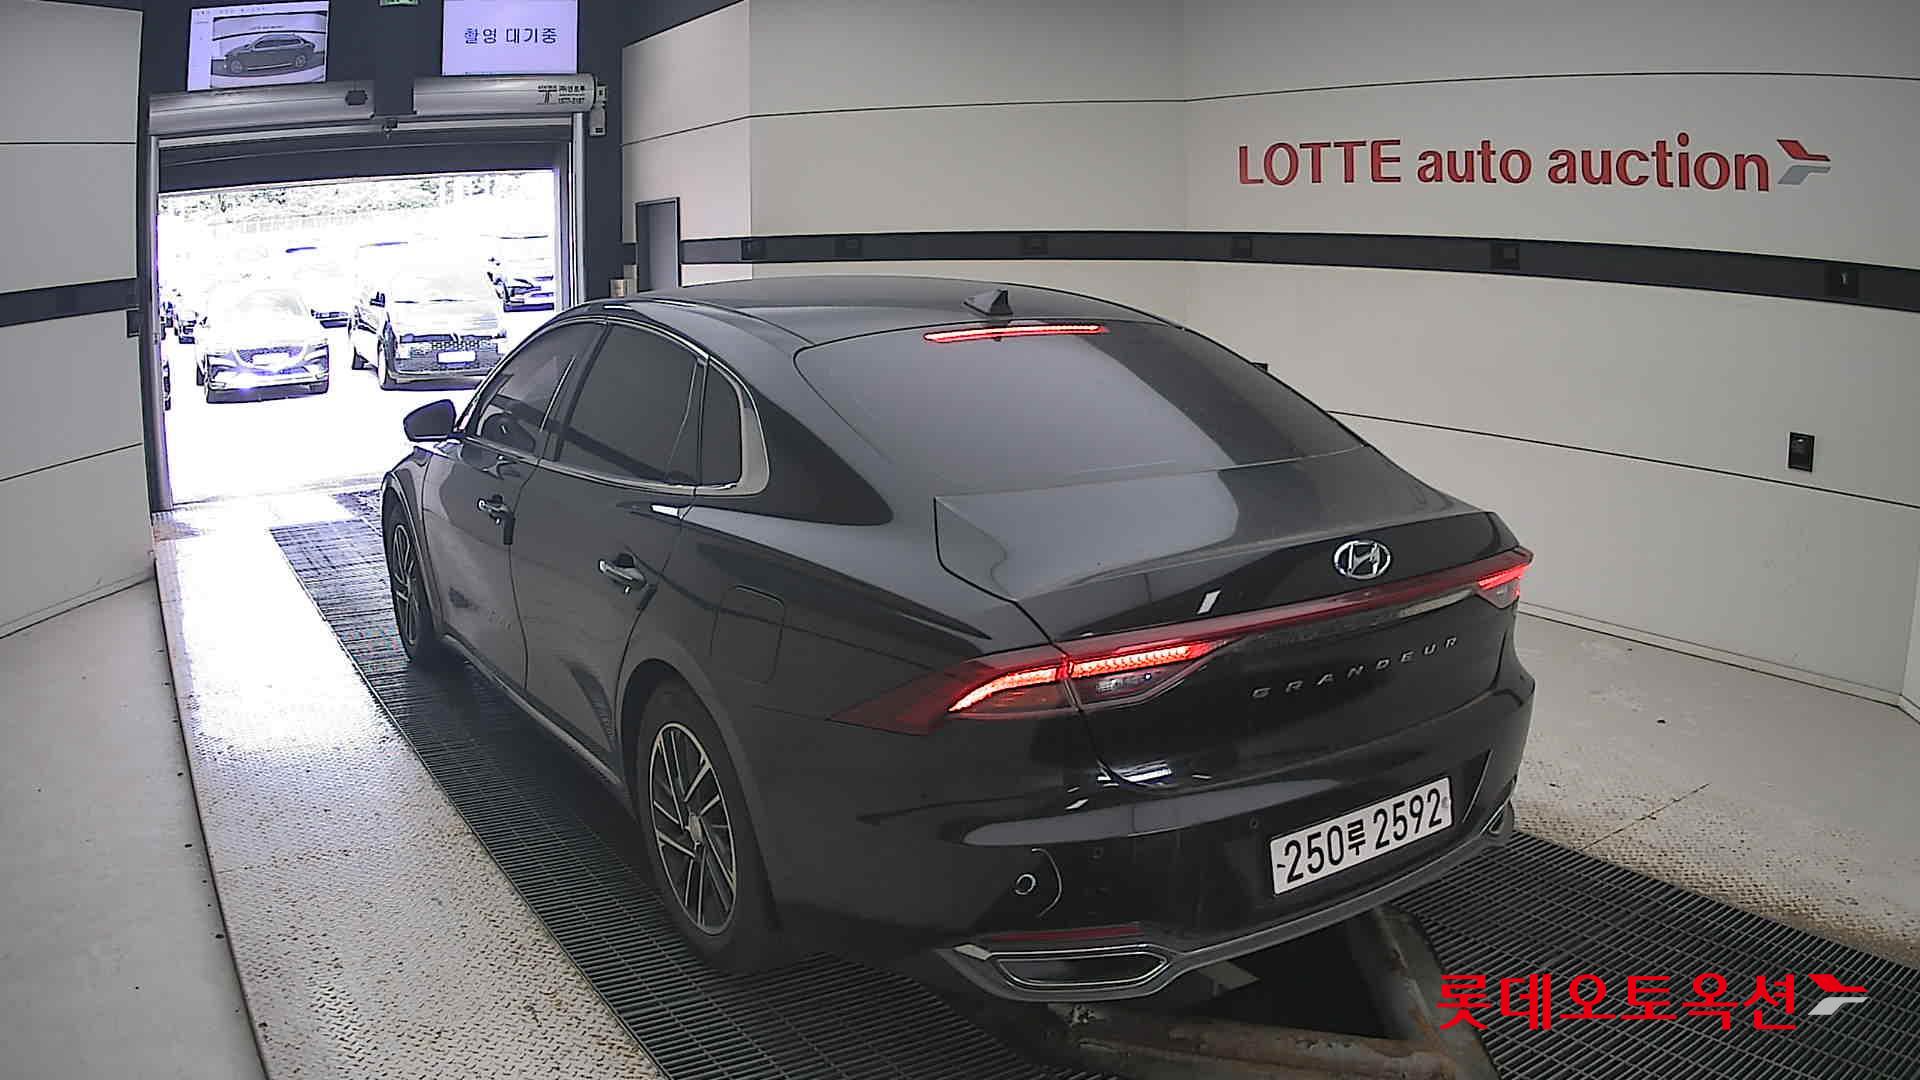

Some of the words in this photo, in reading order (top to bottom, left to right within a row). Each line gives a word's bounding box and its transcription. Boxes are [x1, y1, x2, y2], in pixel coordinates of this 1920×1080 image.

[505, 27, 558, 44] 대기중
[1239, 139, 1402, 185] LOTTE
[1417, 139, 1532, 184] auto
[1547, 132, 1769, 192] auction
[1251, 636, 1457, 699] GRANDEUR
